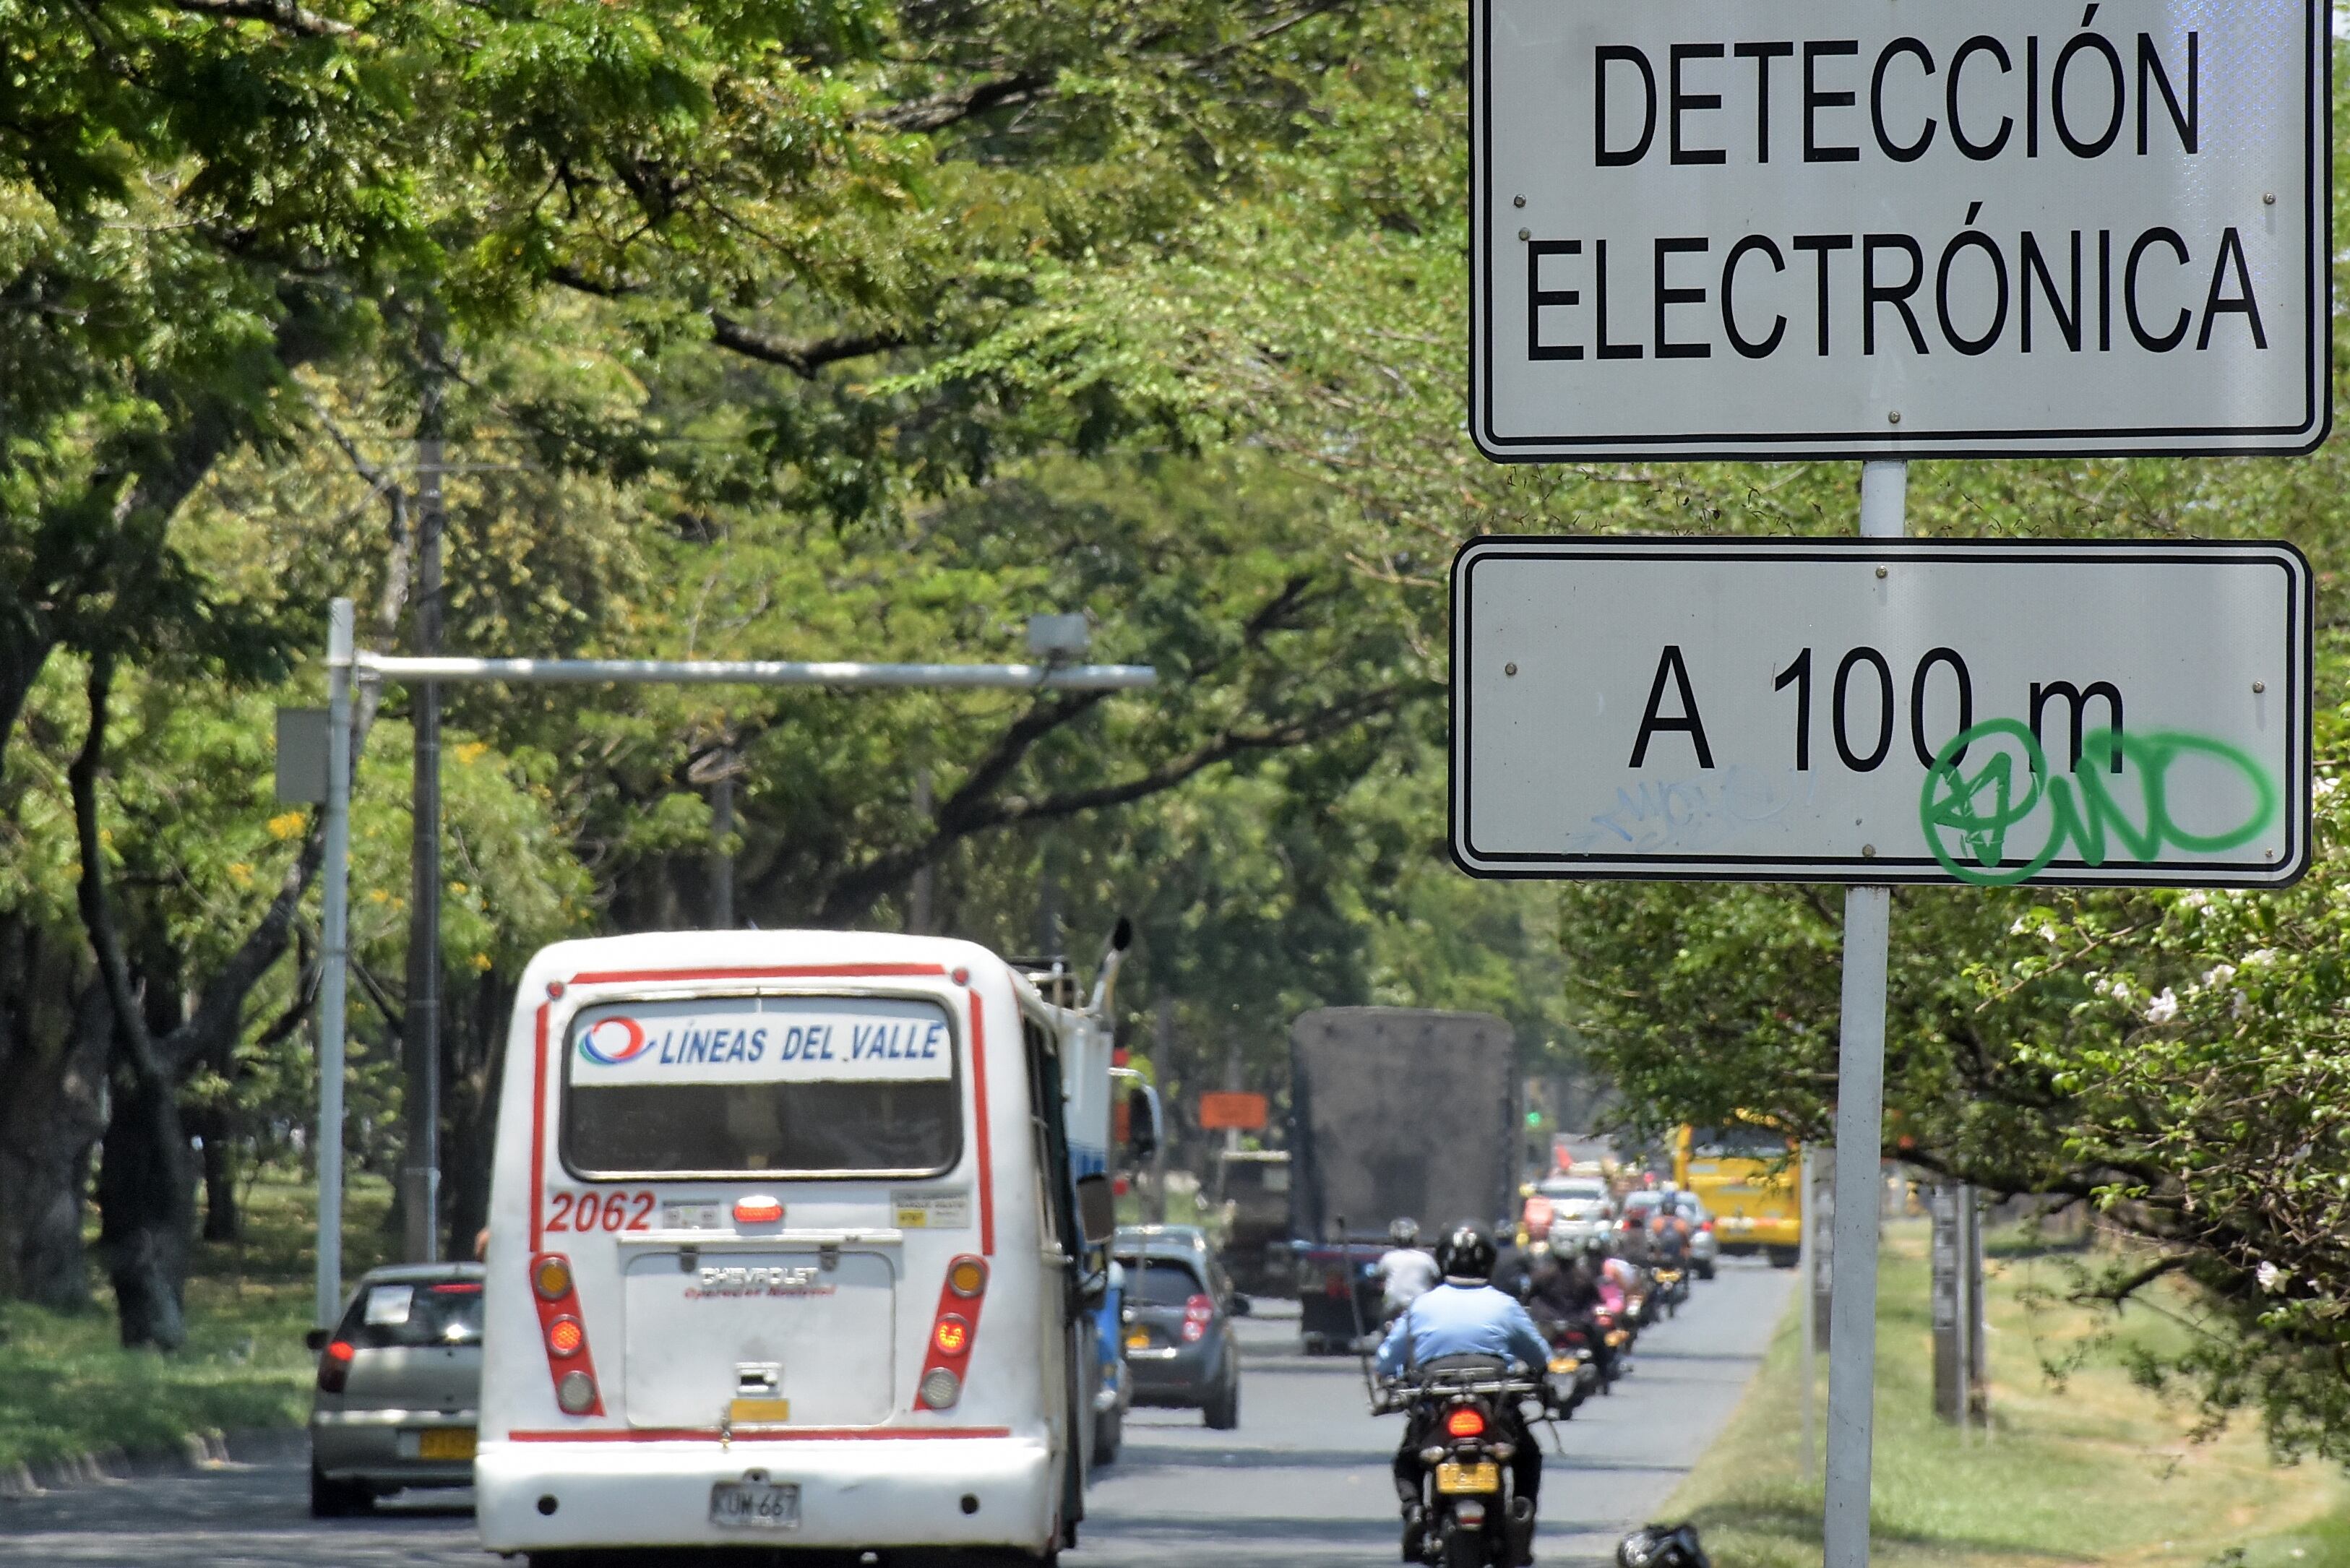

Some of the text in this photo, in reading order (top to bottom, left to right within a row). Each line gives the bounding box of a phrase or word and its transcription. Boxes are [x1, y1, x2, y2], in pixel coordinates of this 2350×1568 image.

[1594, 3, 2198, 168] DETECCIÓN
[1528, 202, 2268, 361] ELECTRÓNICA
[1628, 645, 2125, 774] A 100 m
[659, 1019, 944, 1064] LÍNEAS DEL VALLE
[546, 1190, 657, 1232] 2062
[699, 1267, 819, 1285] CHEVROLET
